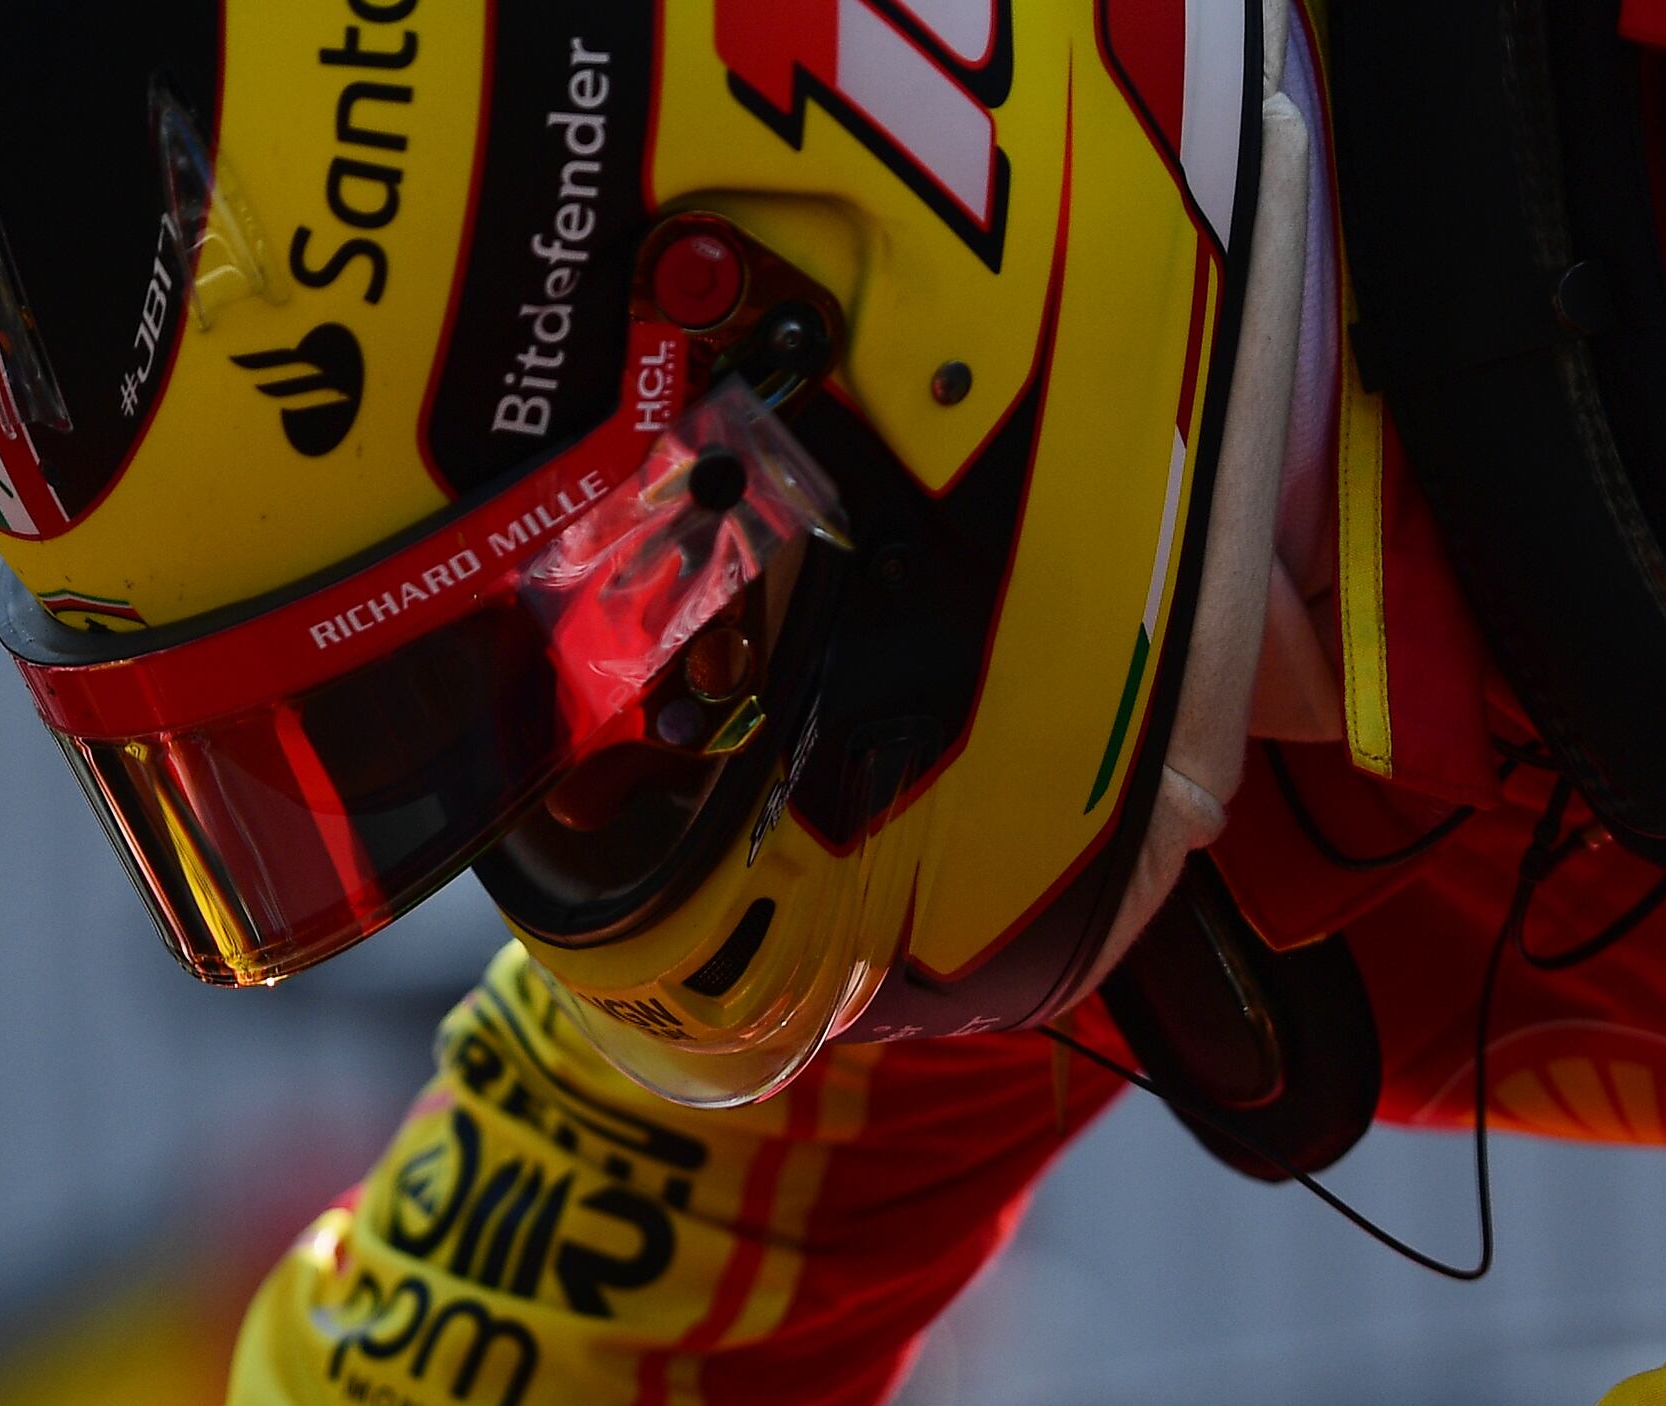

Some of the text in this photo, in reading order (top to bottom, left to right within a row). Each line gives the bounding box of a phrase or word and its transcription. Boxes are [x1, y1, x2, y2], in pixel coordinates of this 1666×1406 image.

[120, 212, 179, 417] #JB17
[492, 37, 612, 438] Bitdefender
[635, 340, 668, 432] HCL
[308, 469, 610, 650] RICHARD MILLE
